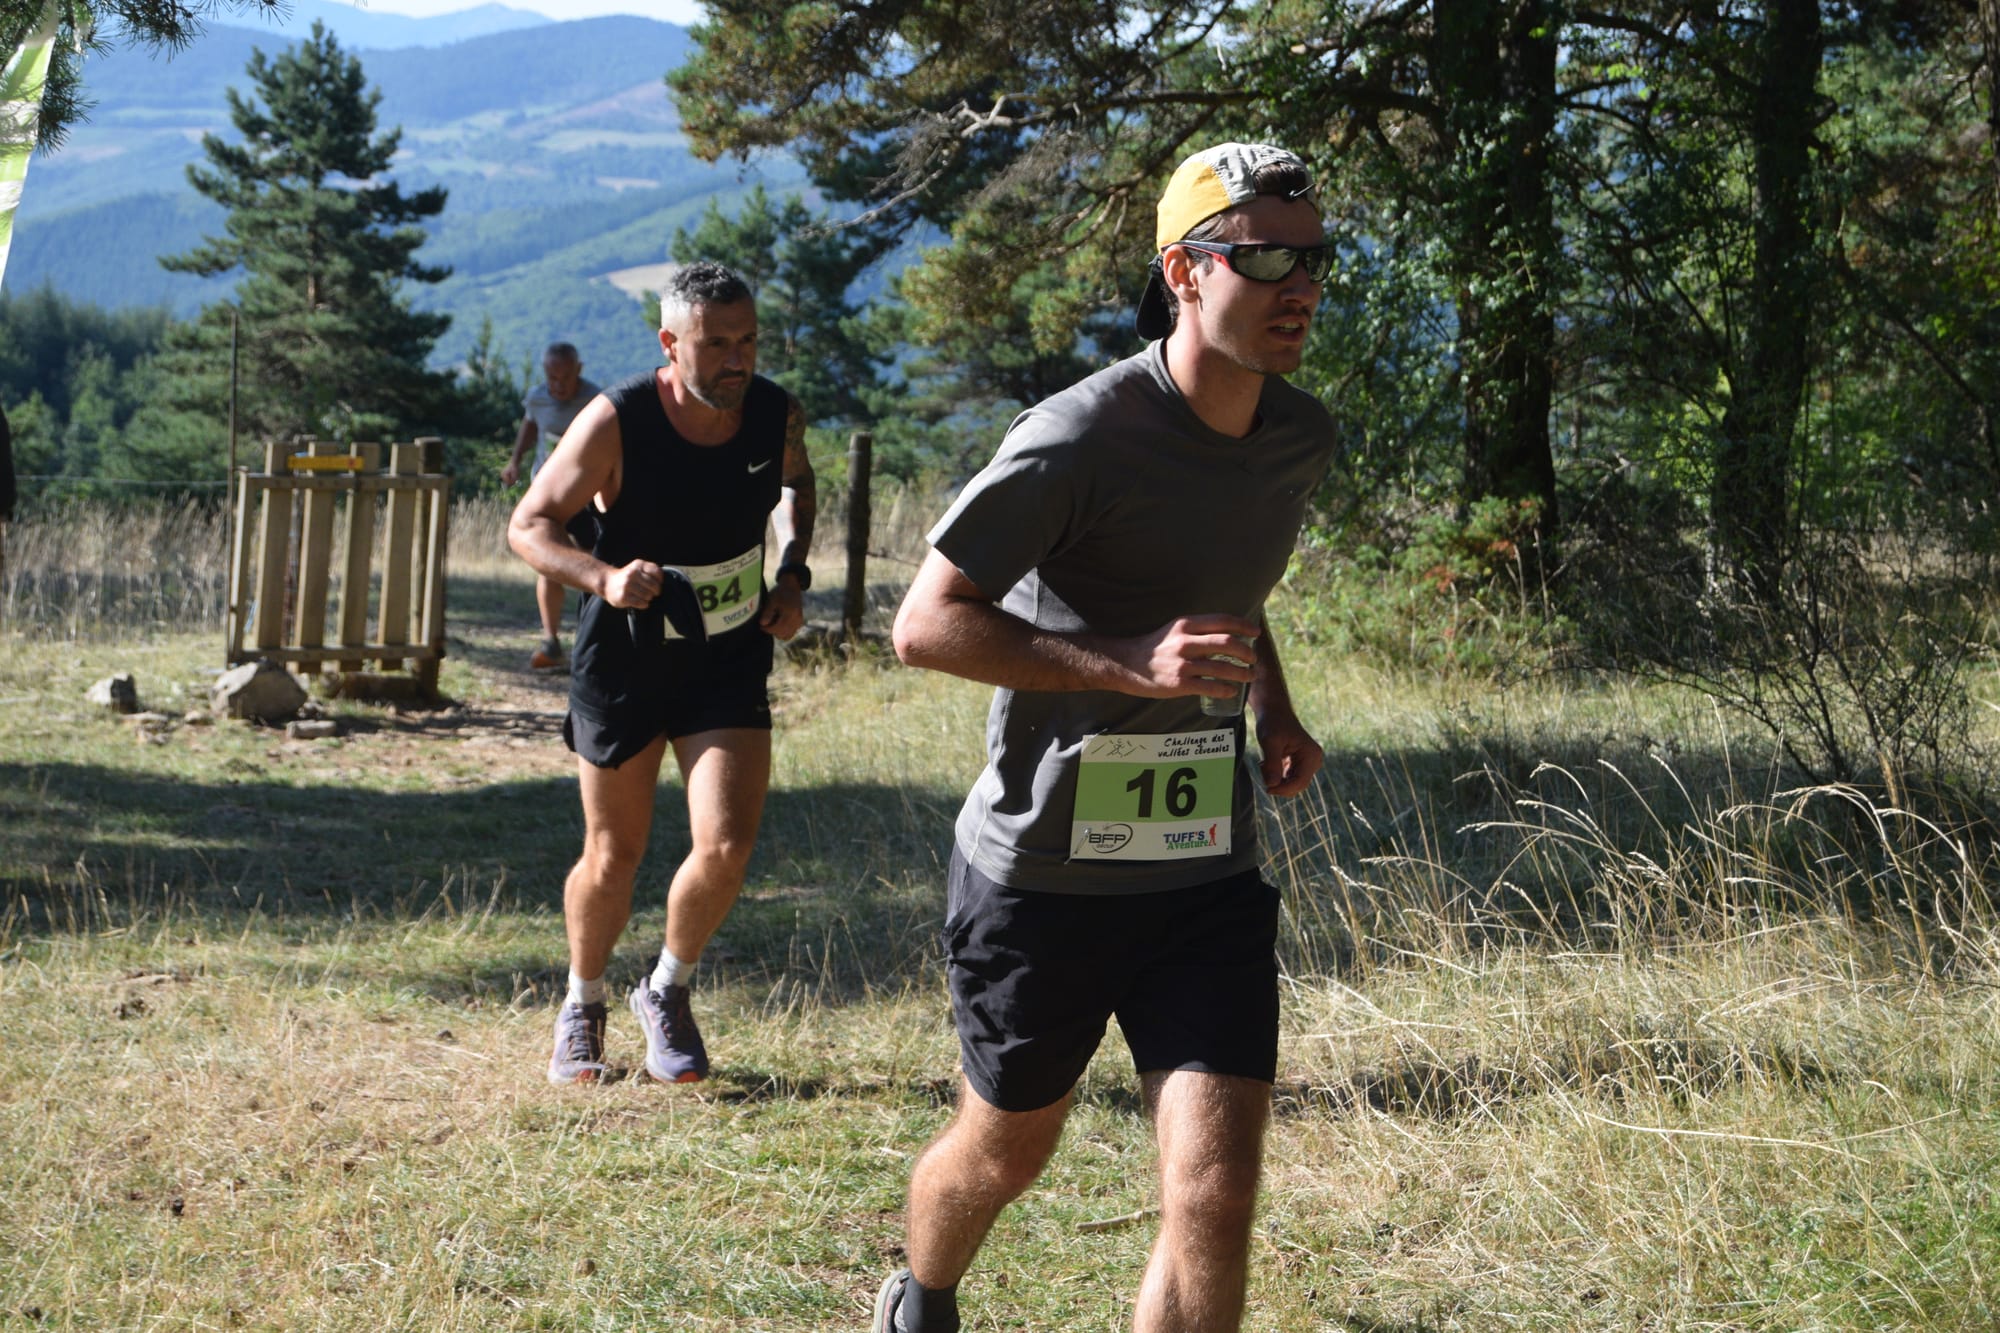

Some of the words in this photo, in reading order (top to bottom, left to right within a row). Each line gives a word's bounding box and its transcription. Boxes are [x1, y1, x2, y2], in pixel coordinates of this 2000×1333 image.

[1164, 736, 1207, 748] Challenge
[1212, 733, 1225, 743] des
[1157, 747, 1190, 758] vallées
[1126, 766, 1198, 818] 16
[1088, 833, 1126, 844] BFP
[1163, 830, 1206, 844] TUFF'S
[1166, 839, 1209, 851] Aventure
